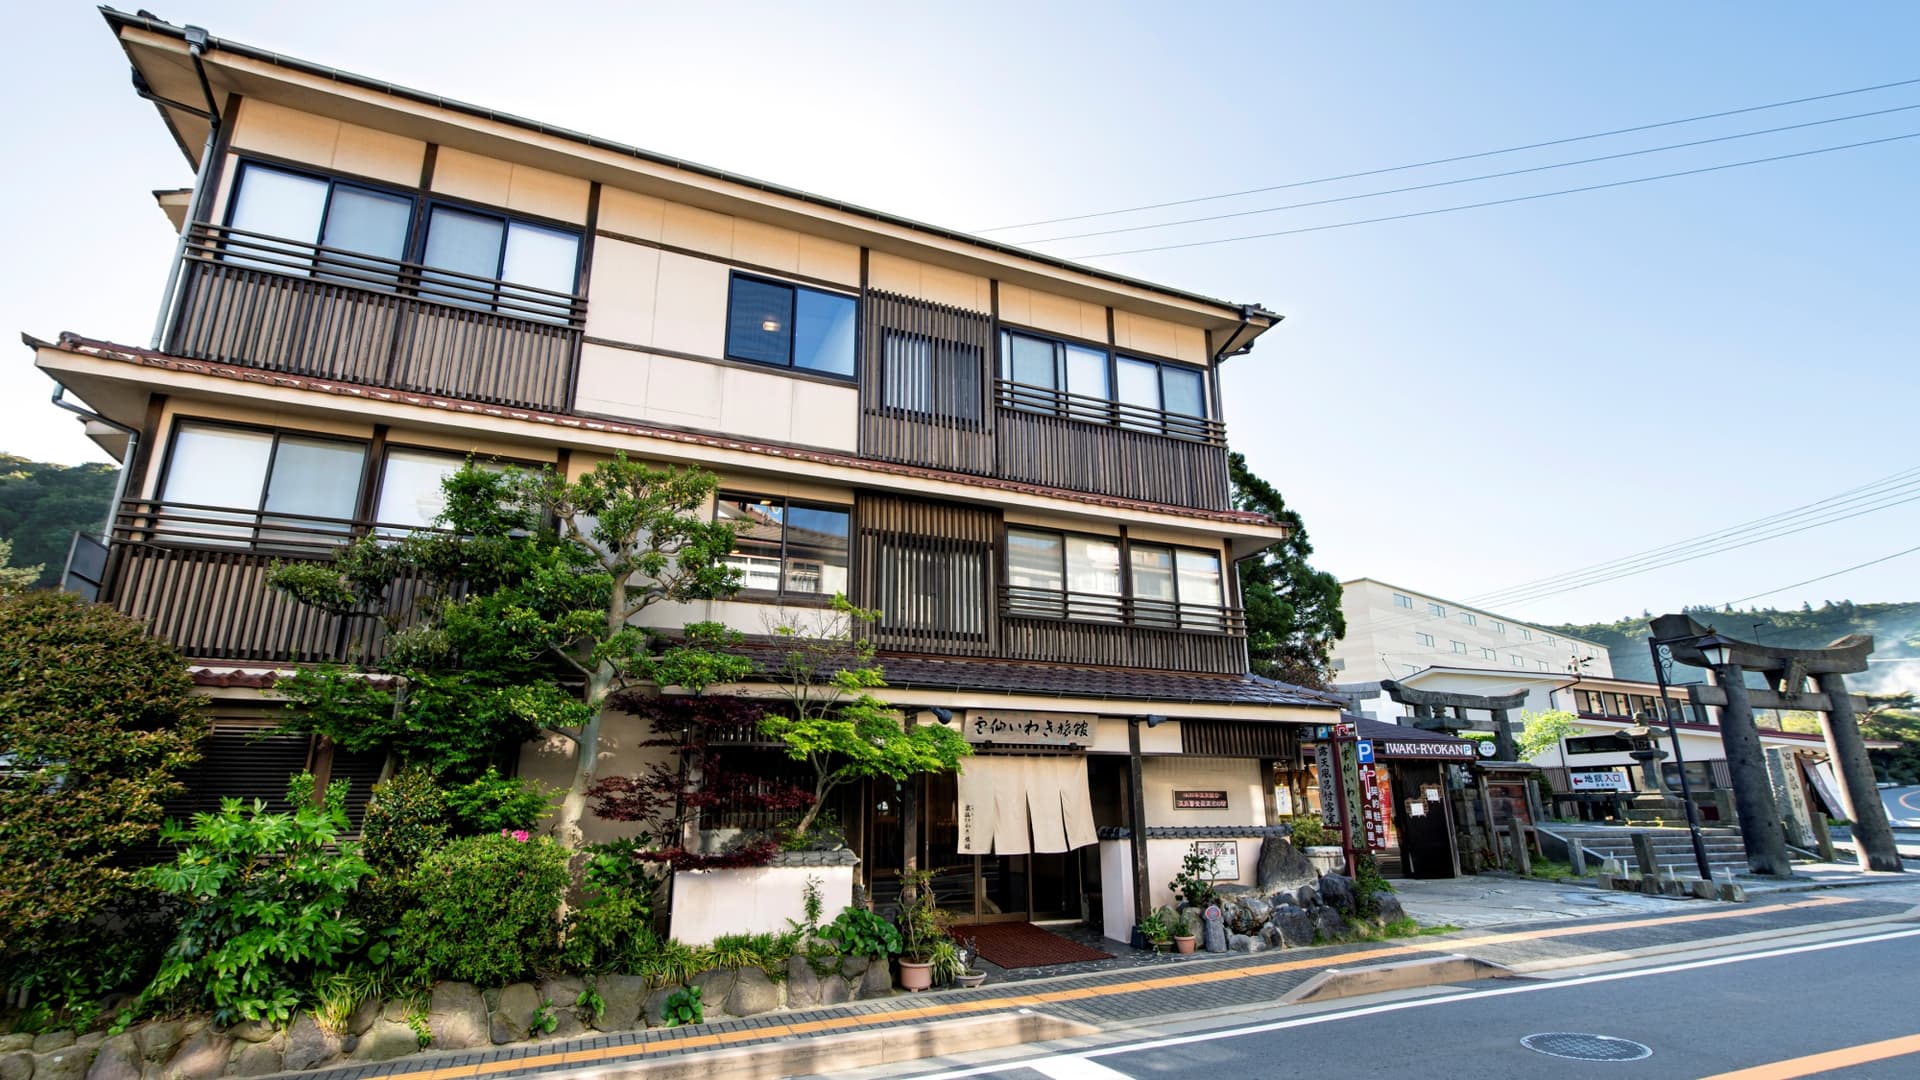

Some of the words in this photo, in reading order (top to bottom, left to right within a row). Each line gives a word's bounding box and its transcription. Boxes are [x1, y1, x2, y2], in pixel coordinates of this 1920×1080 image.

[974, 716, 1088, 737] 雲仙いわき旅館
[1358, 744, 1371, 760] P
[1385, 743, 1463, 755] IWAKI-RYOKAN
[1318, 746, 1336, 825] 露天風呂付客室
[1584, 774, 1621, 783] 地獄入口
